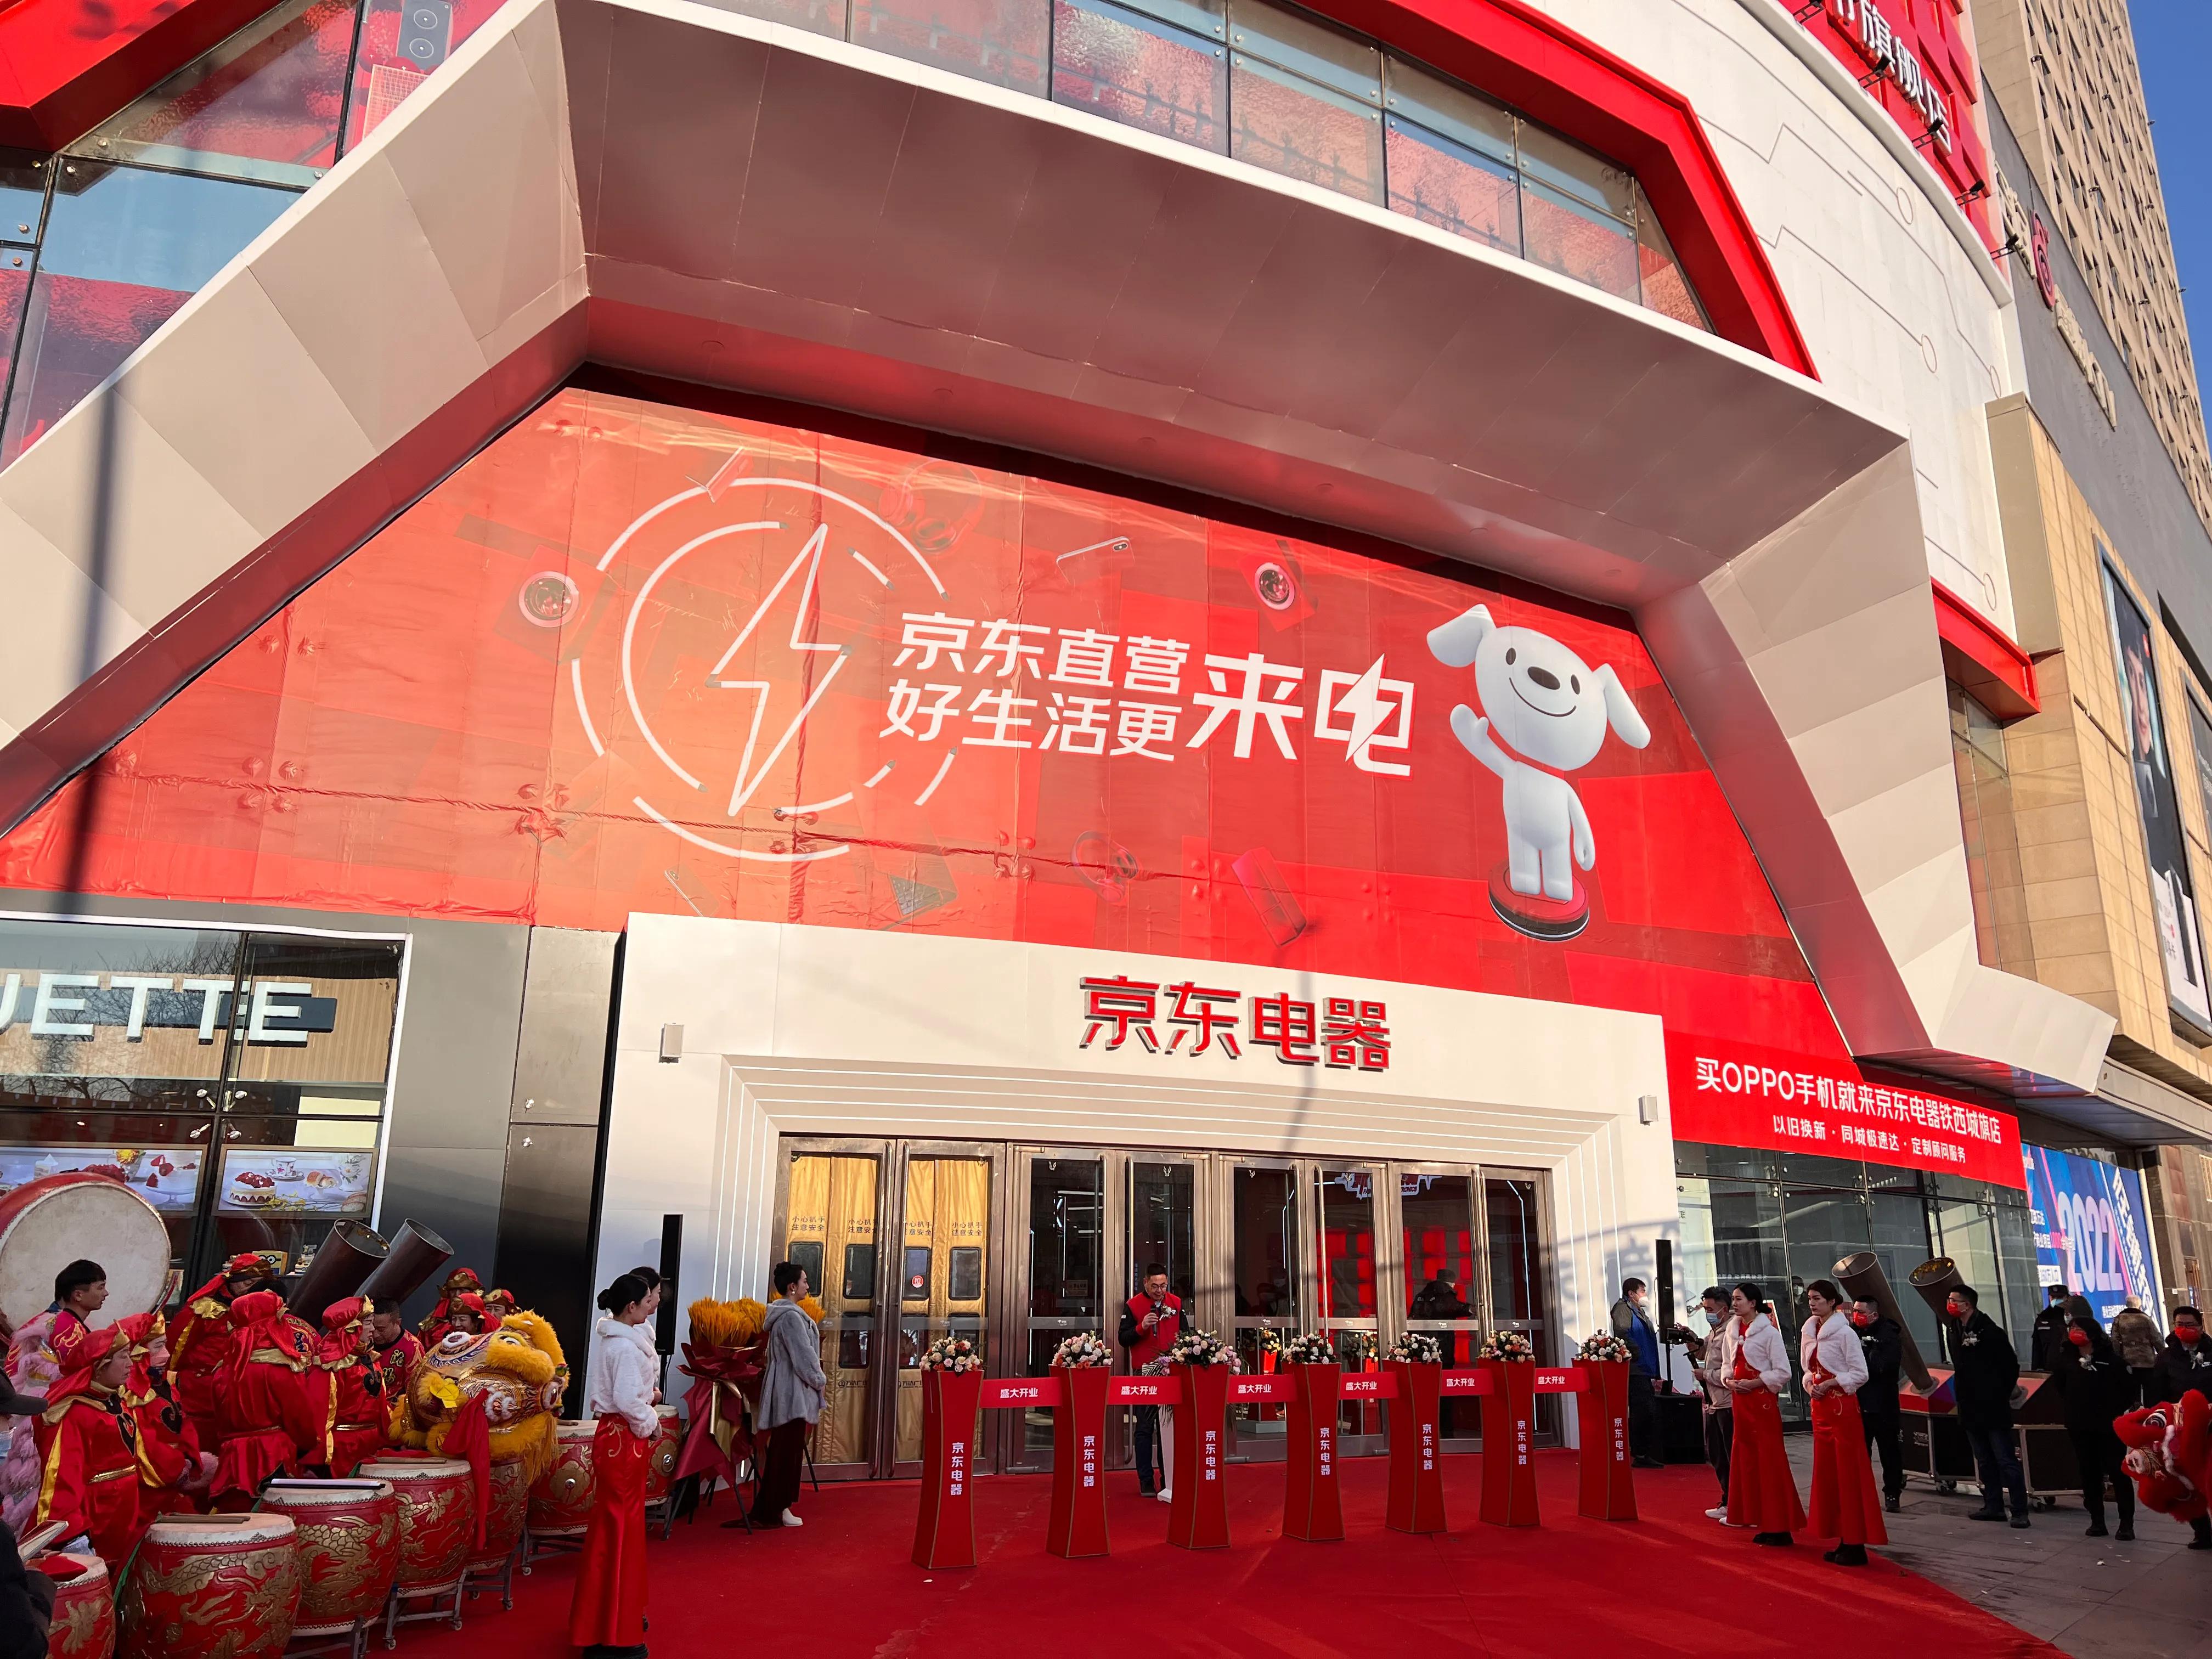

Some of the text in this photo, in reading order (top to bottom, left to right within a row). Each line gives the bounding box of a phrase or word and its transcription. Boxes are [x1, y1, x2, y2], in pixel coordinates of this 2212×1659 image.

[891, 611, 1190, 695] 京东直营
[879, 678, 1182, 762] 好生活更
[1187, 653, 1415, 777] 来电
[1079, 975, 1392, 1070] 京东电器
[1773, 1114, 1966, 1164] 以旧换新 同城极速达 定制顾问服务
[792, 1215, 826, 1223] 小心扒手
[952, 1221, 983, 1229] 小心扒手
[2058, 1191, 2124, 1293] 2022
[1000, 1387, 1039, 1399] 盛大开业
[1121, 1385, 1158, 1396] 盛大开业
[1238, 1384, 1272, 1394] 盛大开业
[1345, 1381, 1378, 1391] 盛大开业
[1446, 1378, 1475, 1387] 盛大开业
[1538, 1376, 1565, 1385] 盛大开业
[1083, 1435, 1095, 1487] 京东电器
[1205, 1430, 1216, 1480] 京东电器
[1320, 1427, 1331, 1476] 京东电器
[1423, 1424, 1433, 1470] 京东电器
[1517, 1420, 1527, 1465] 京东电器
[1614, 1418, 1624, 1461] 京东电器
[950, 1442, 964, 1496] 京东电器
